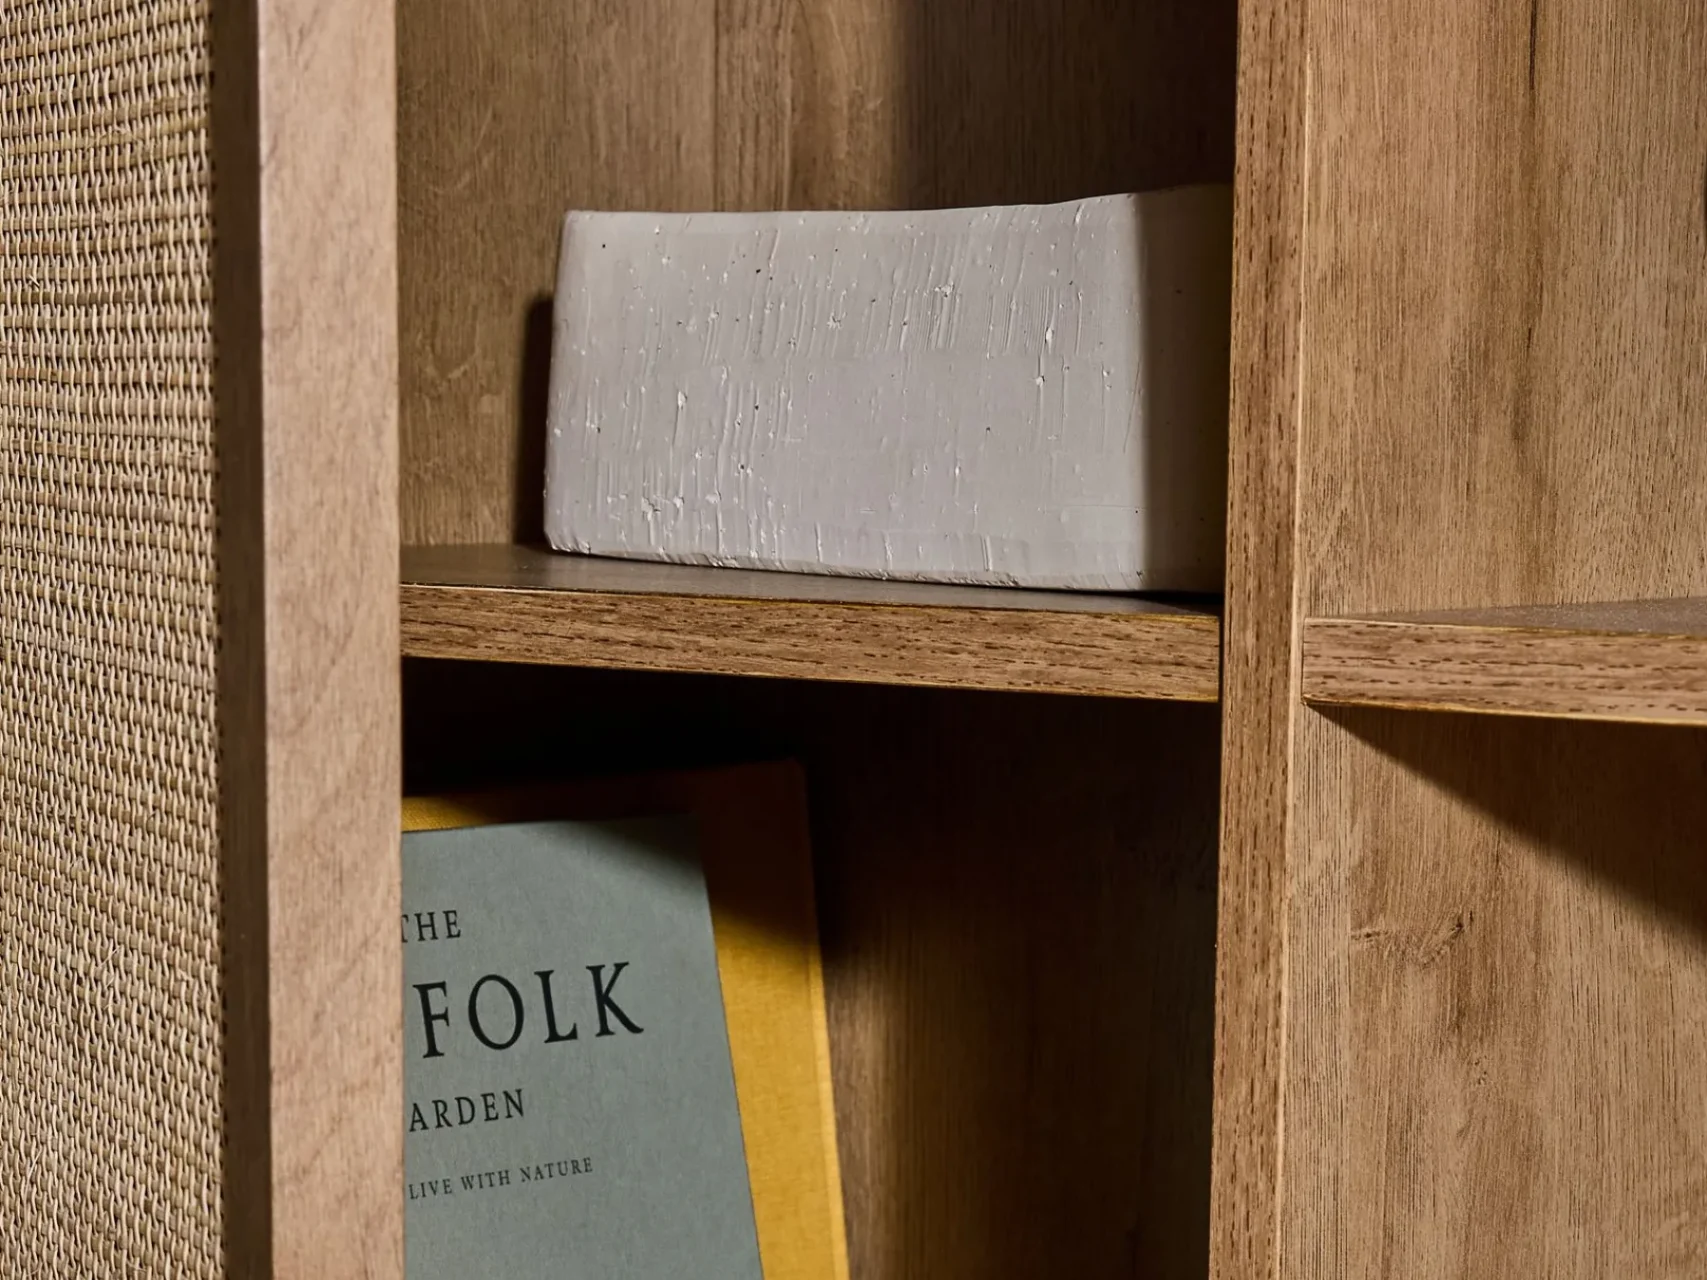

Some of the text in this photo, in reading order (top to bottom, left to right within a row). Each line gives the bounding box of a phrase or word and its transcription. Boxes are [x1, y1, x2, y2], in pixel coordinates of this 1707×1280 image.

[411, 961, 645, 1059] FOLK
[408, 1157, 594, 1200] LIVE WITH NATURE
